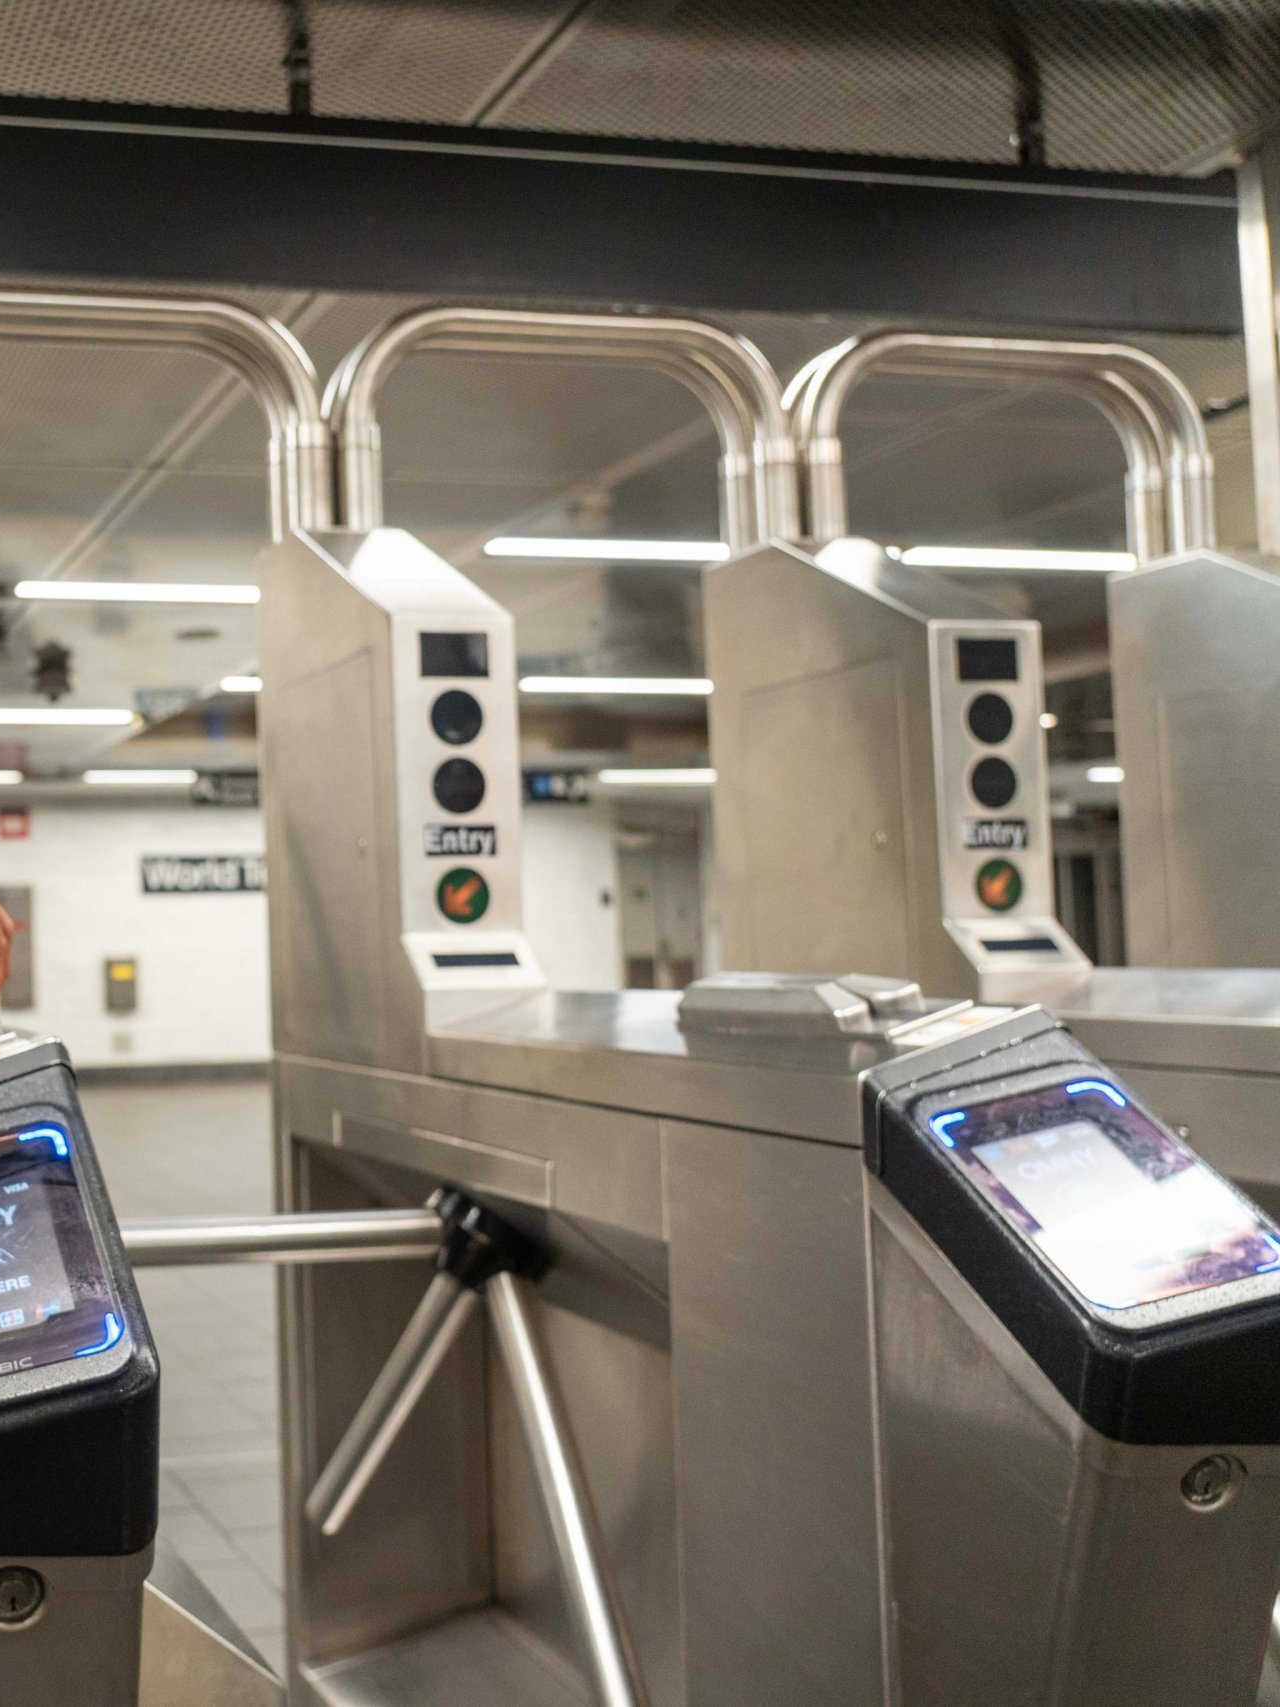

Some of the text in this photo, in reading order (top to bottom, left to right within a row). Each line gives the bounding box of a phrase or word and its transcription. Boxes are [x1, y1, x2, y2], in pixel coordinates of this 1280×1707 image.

[424, 826, 493, 855] Entry
[963, 821, 1023, 848] Entry
[143, 859, 241, 890] World
